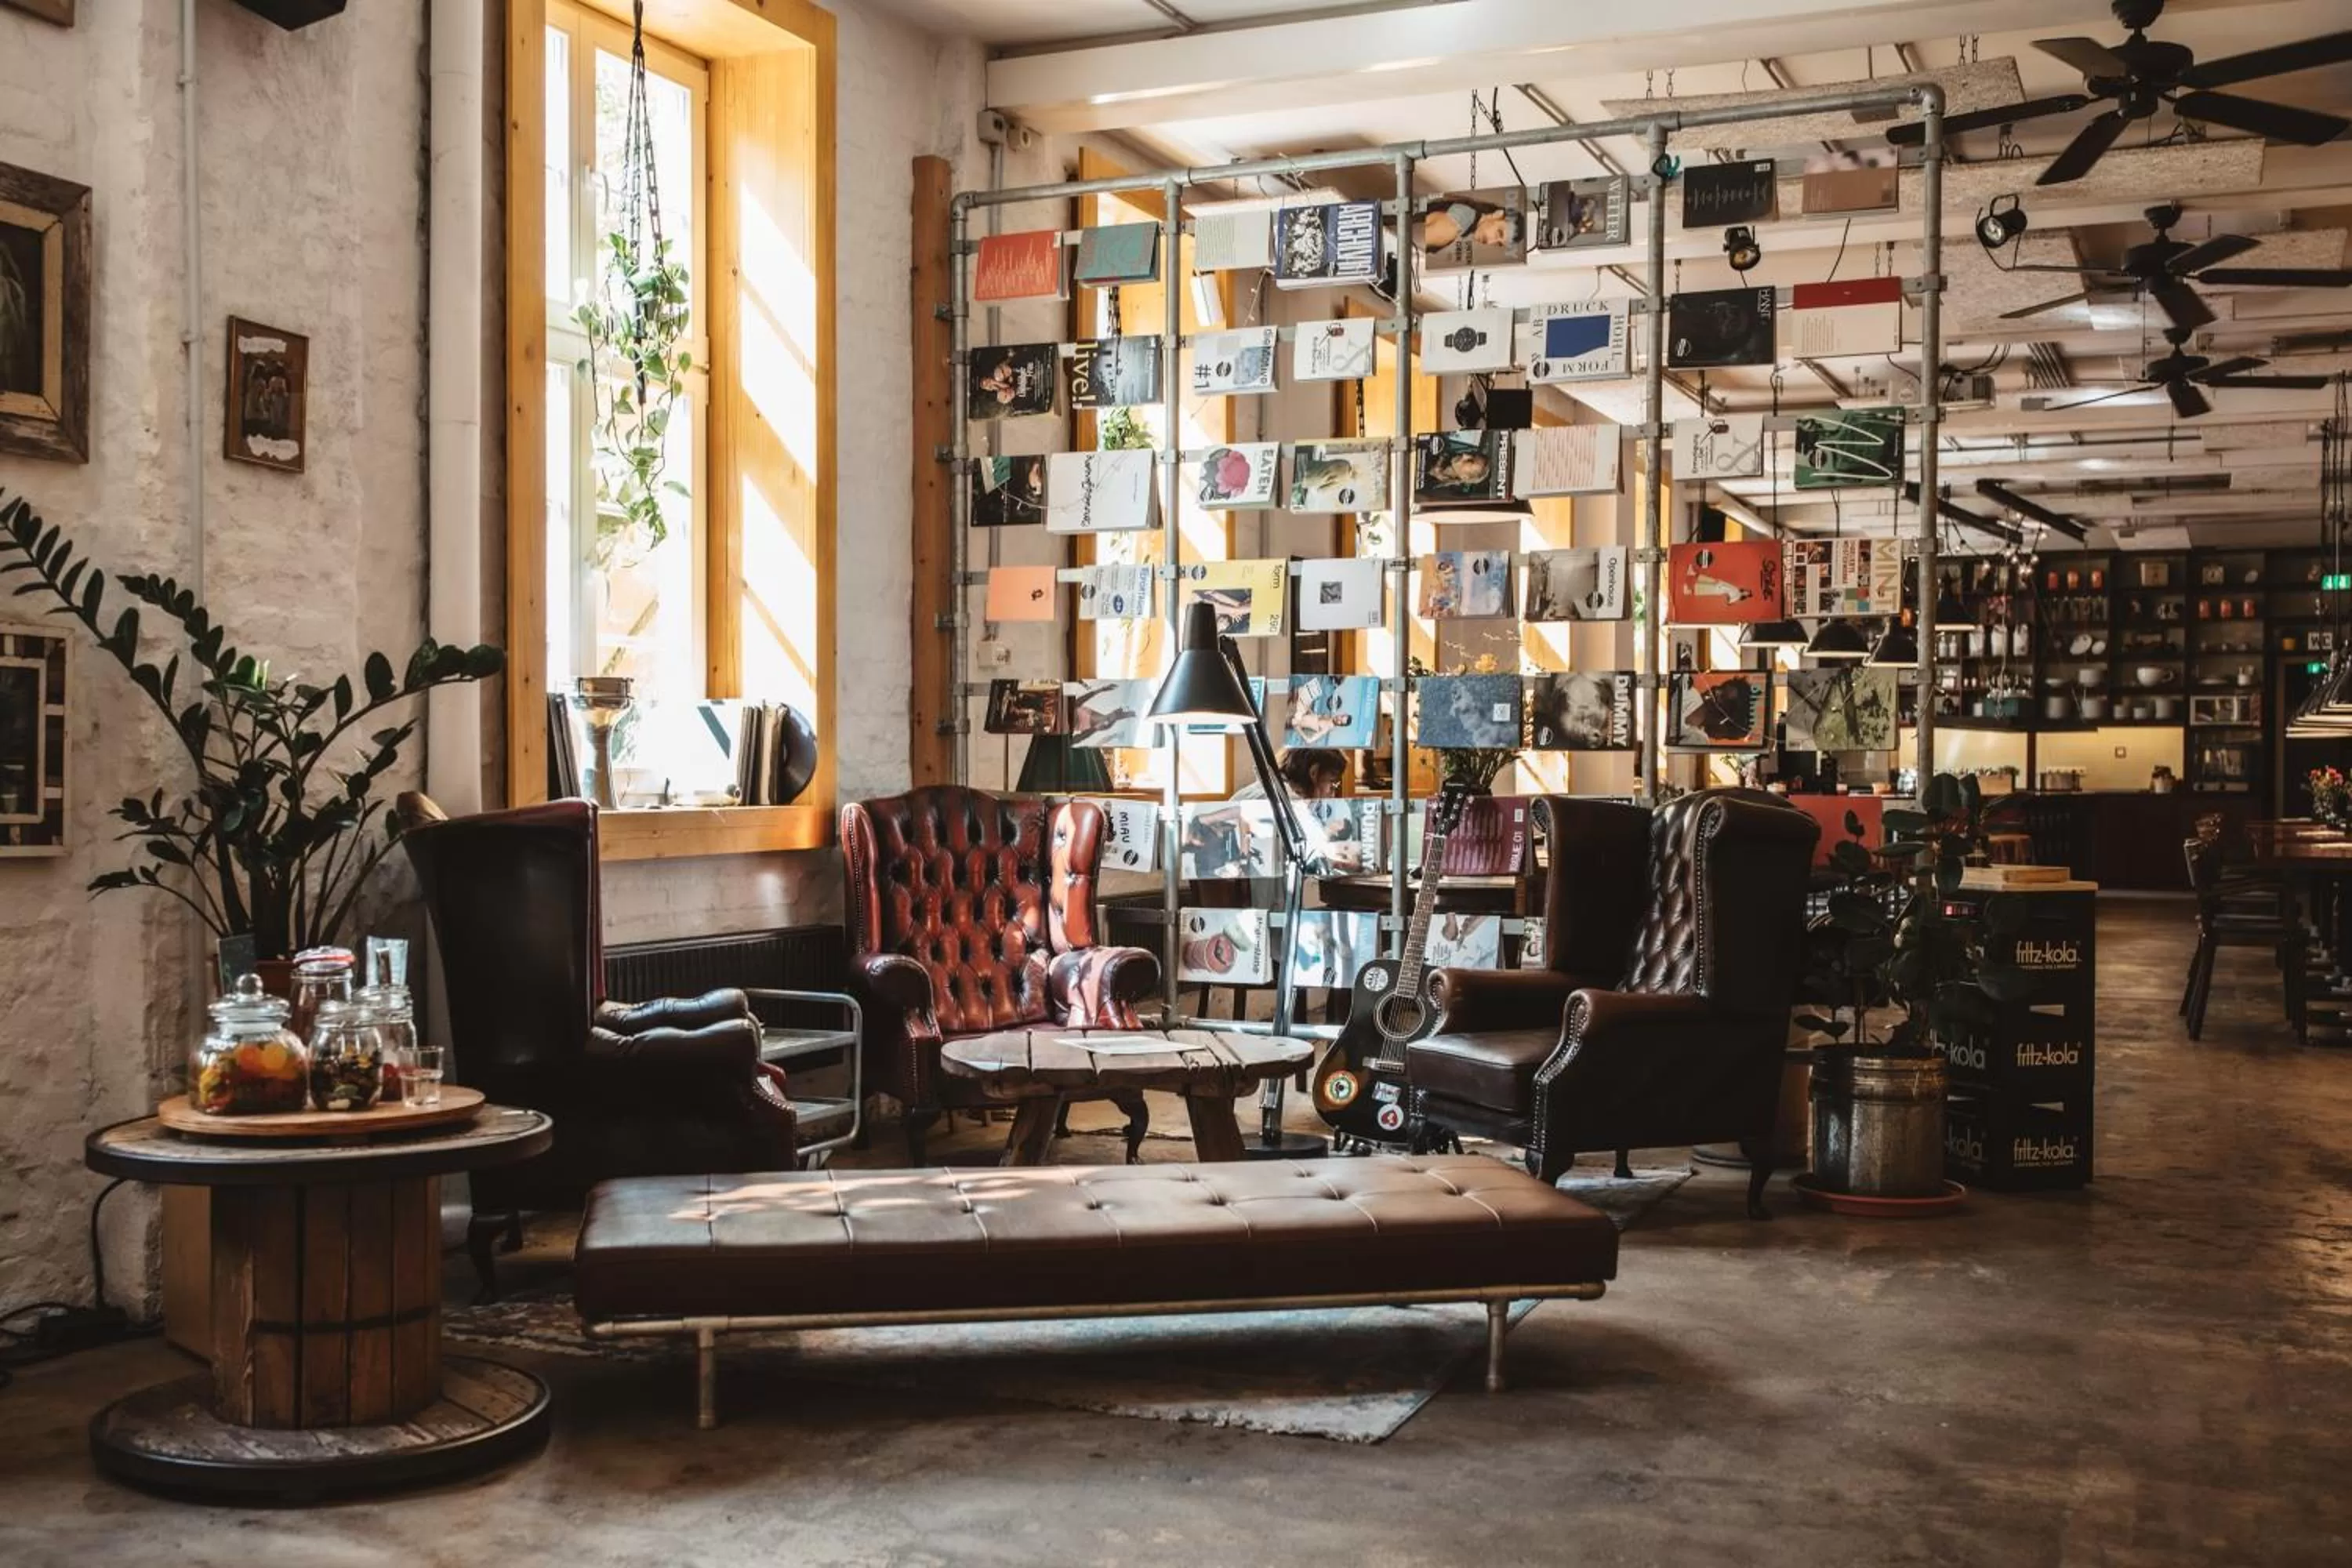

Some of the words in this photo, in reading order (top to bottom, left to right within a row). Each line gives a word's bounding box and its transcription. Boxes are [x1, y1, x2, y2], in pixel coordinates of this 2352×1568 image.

[1072, 339, 1098, 402] live!
[1194, 364, 1211, 389] #1
[1257, 448, 1275, 495] EATEN
[1497, 430, 1509, 499] PRESENT
[1613, 674, 1632, 747] DUMMY
[1120, 811, 1130, 843] MIAU
[1361, 801, 1377, 869] DUMMY
[2016, 941, 2077, 964] fritz-kola
[2016, 1041, 2078, 1067] fritz-kola
[2013, 1136, 2074, 1161] fritz-kola
